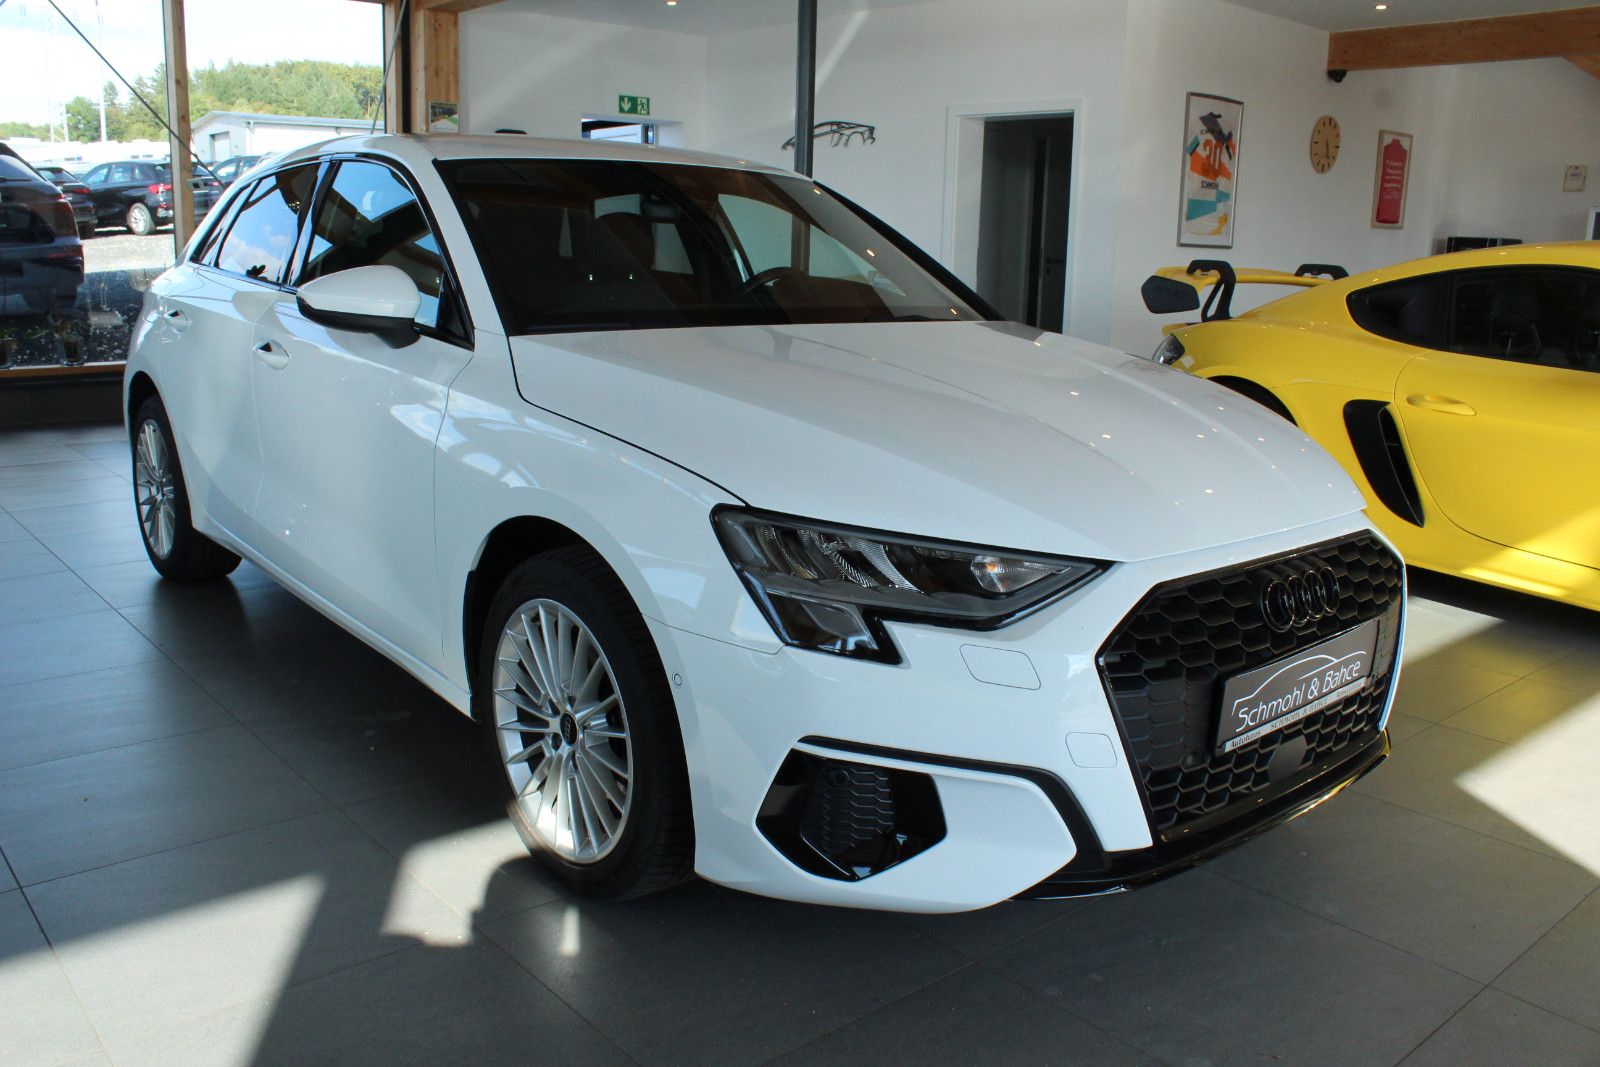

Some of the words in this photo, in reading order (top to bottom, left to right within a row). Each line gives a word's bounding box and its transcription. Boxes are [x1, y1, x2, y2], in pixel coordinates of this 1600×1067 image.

[1235, 684, 1306, 732] Schmohl
[1308, 677, 1319, 700] &
[1322, 660, 1361, 692] Bahce
[1229, 730, 1261, 749] Autohaus
